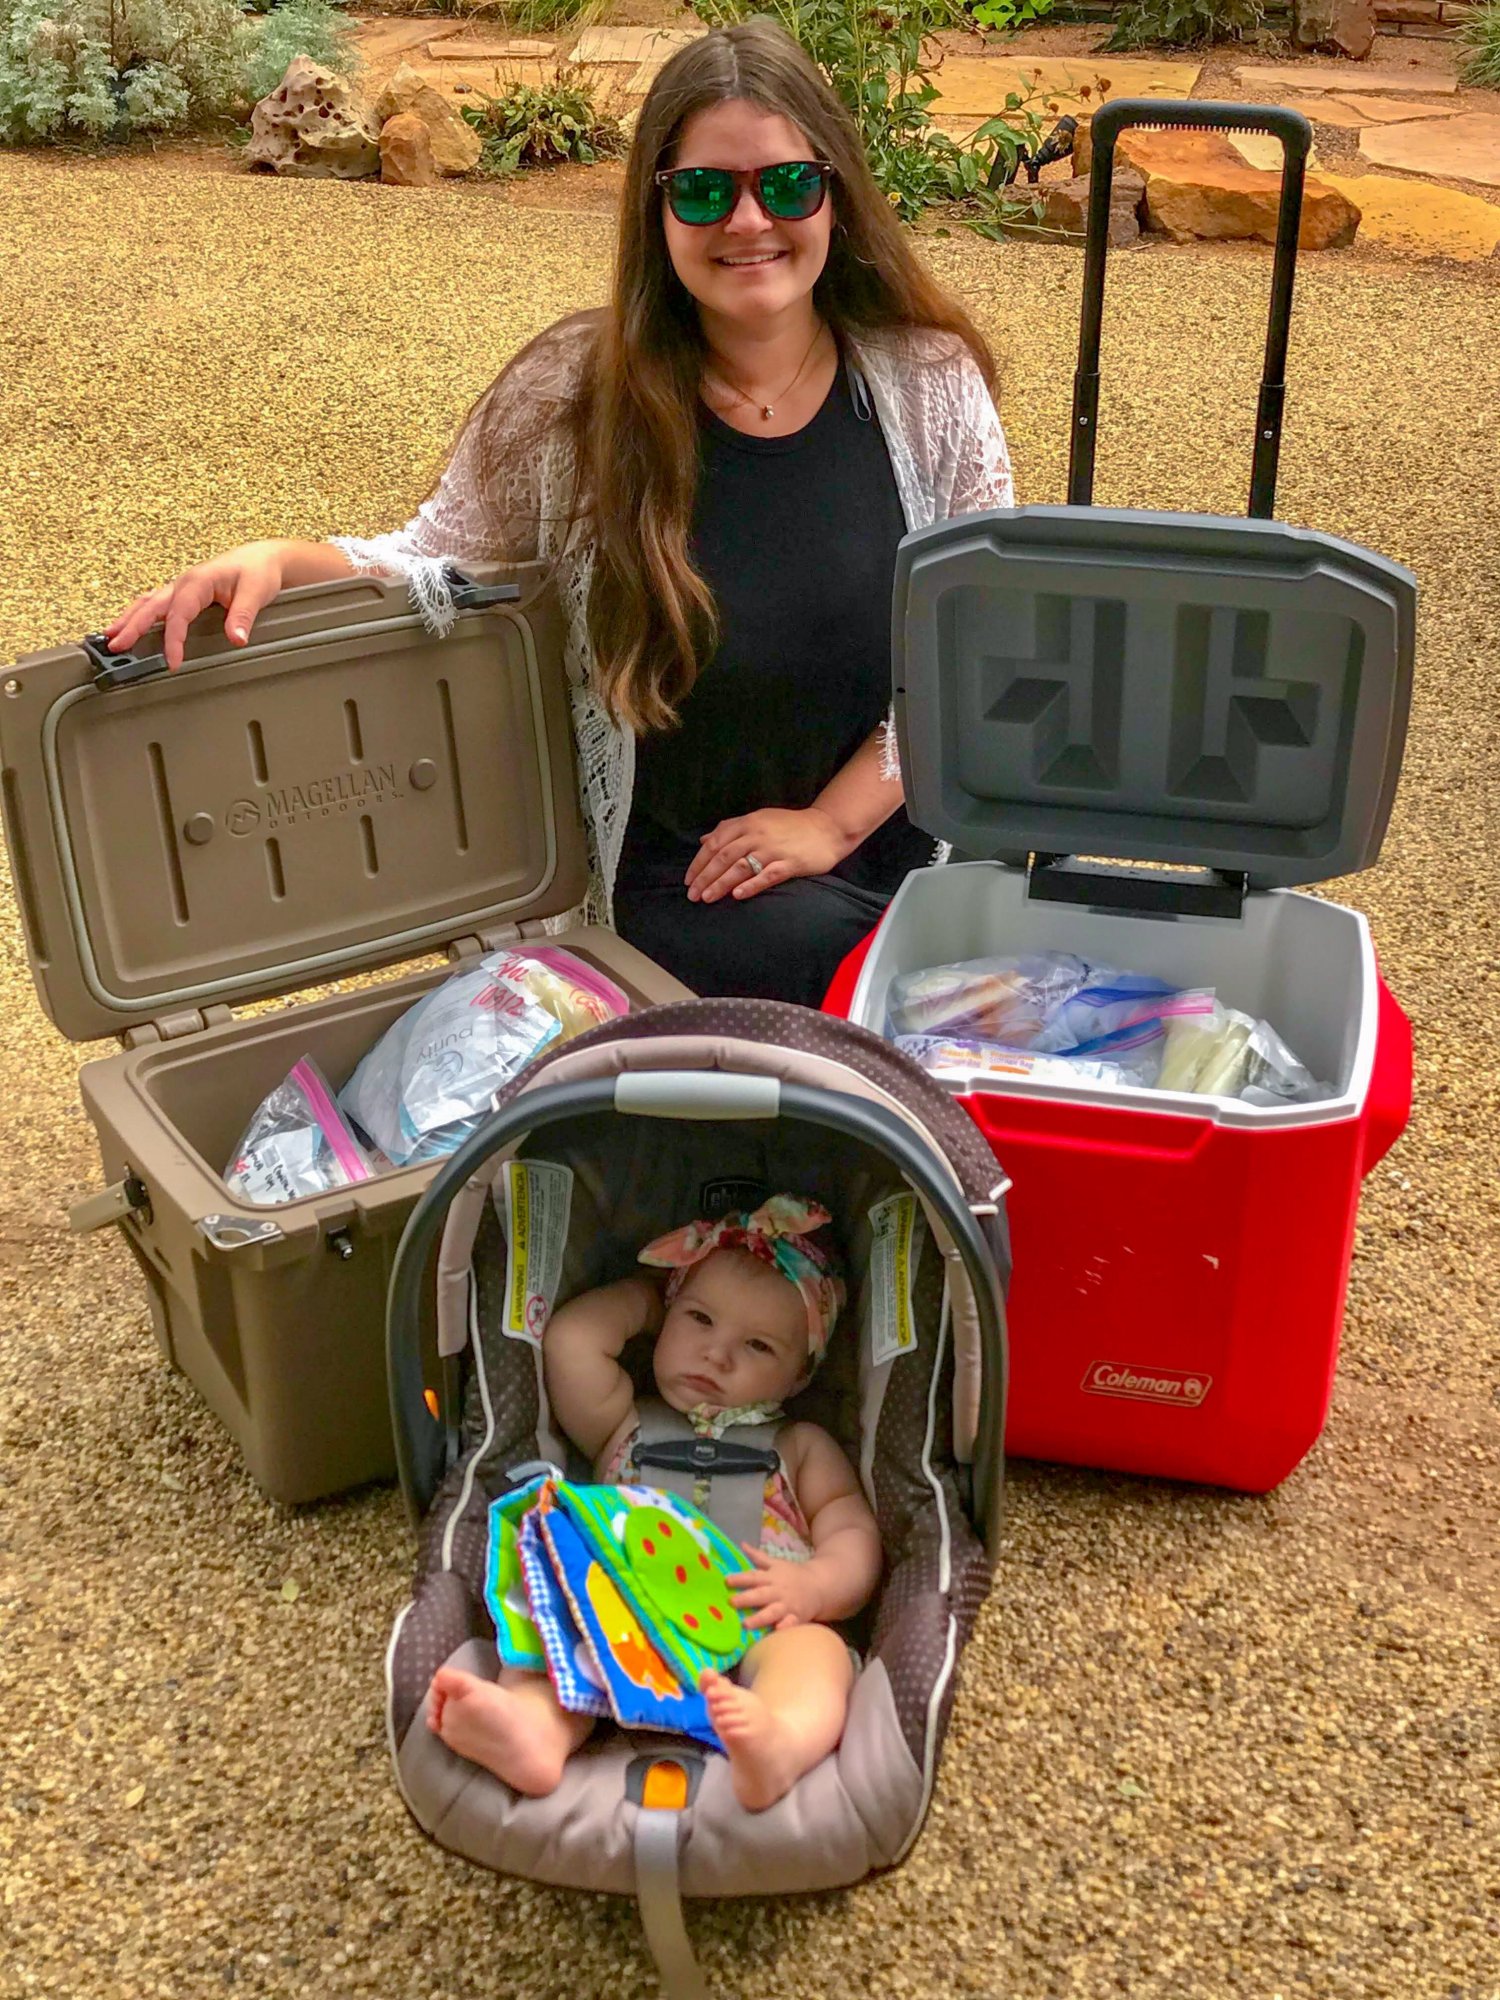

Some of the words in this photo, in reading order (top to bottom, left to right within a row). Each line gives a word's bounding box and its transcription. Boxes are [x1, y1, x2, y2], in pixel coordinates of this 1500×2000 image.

[266, 764, 397, 818] MAGELLAN
[269, 791, 399, 829] OUTDOORS
[416, 1025, 474, 1063] purity
[515, 1172, 526, 1238] ADVERTENCIA
[515, 1264, 525, 1313] WARNING
[1093, 1365, 1182, 1395] Coleman
